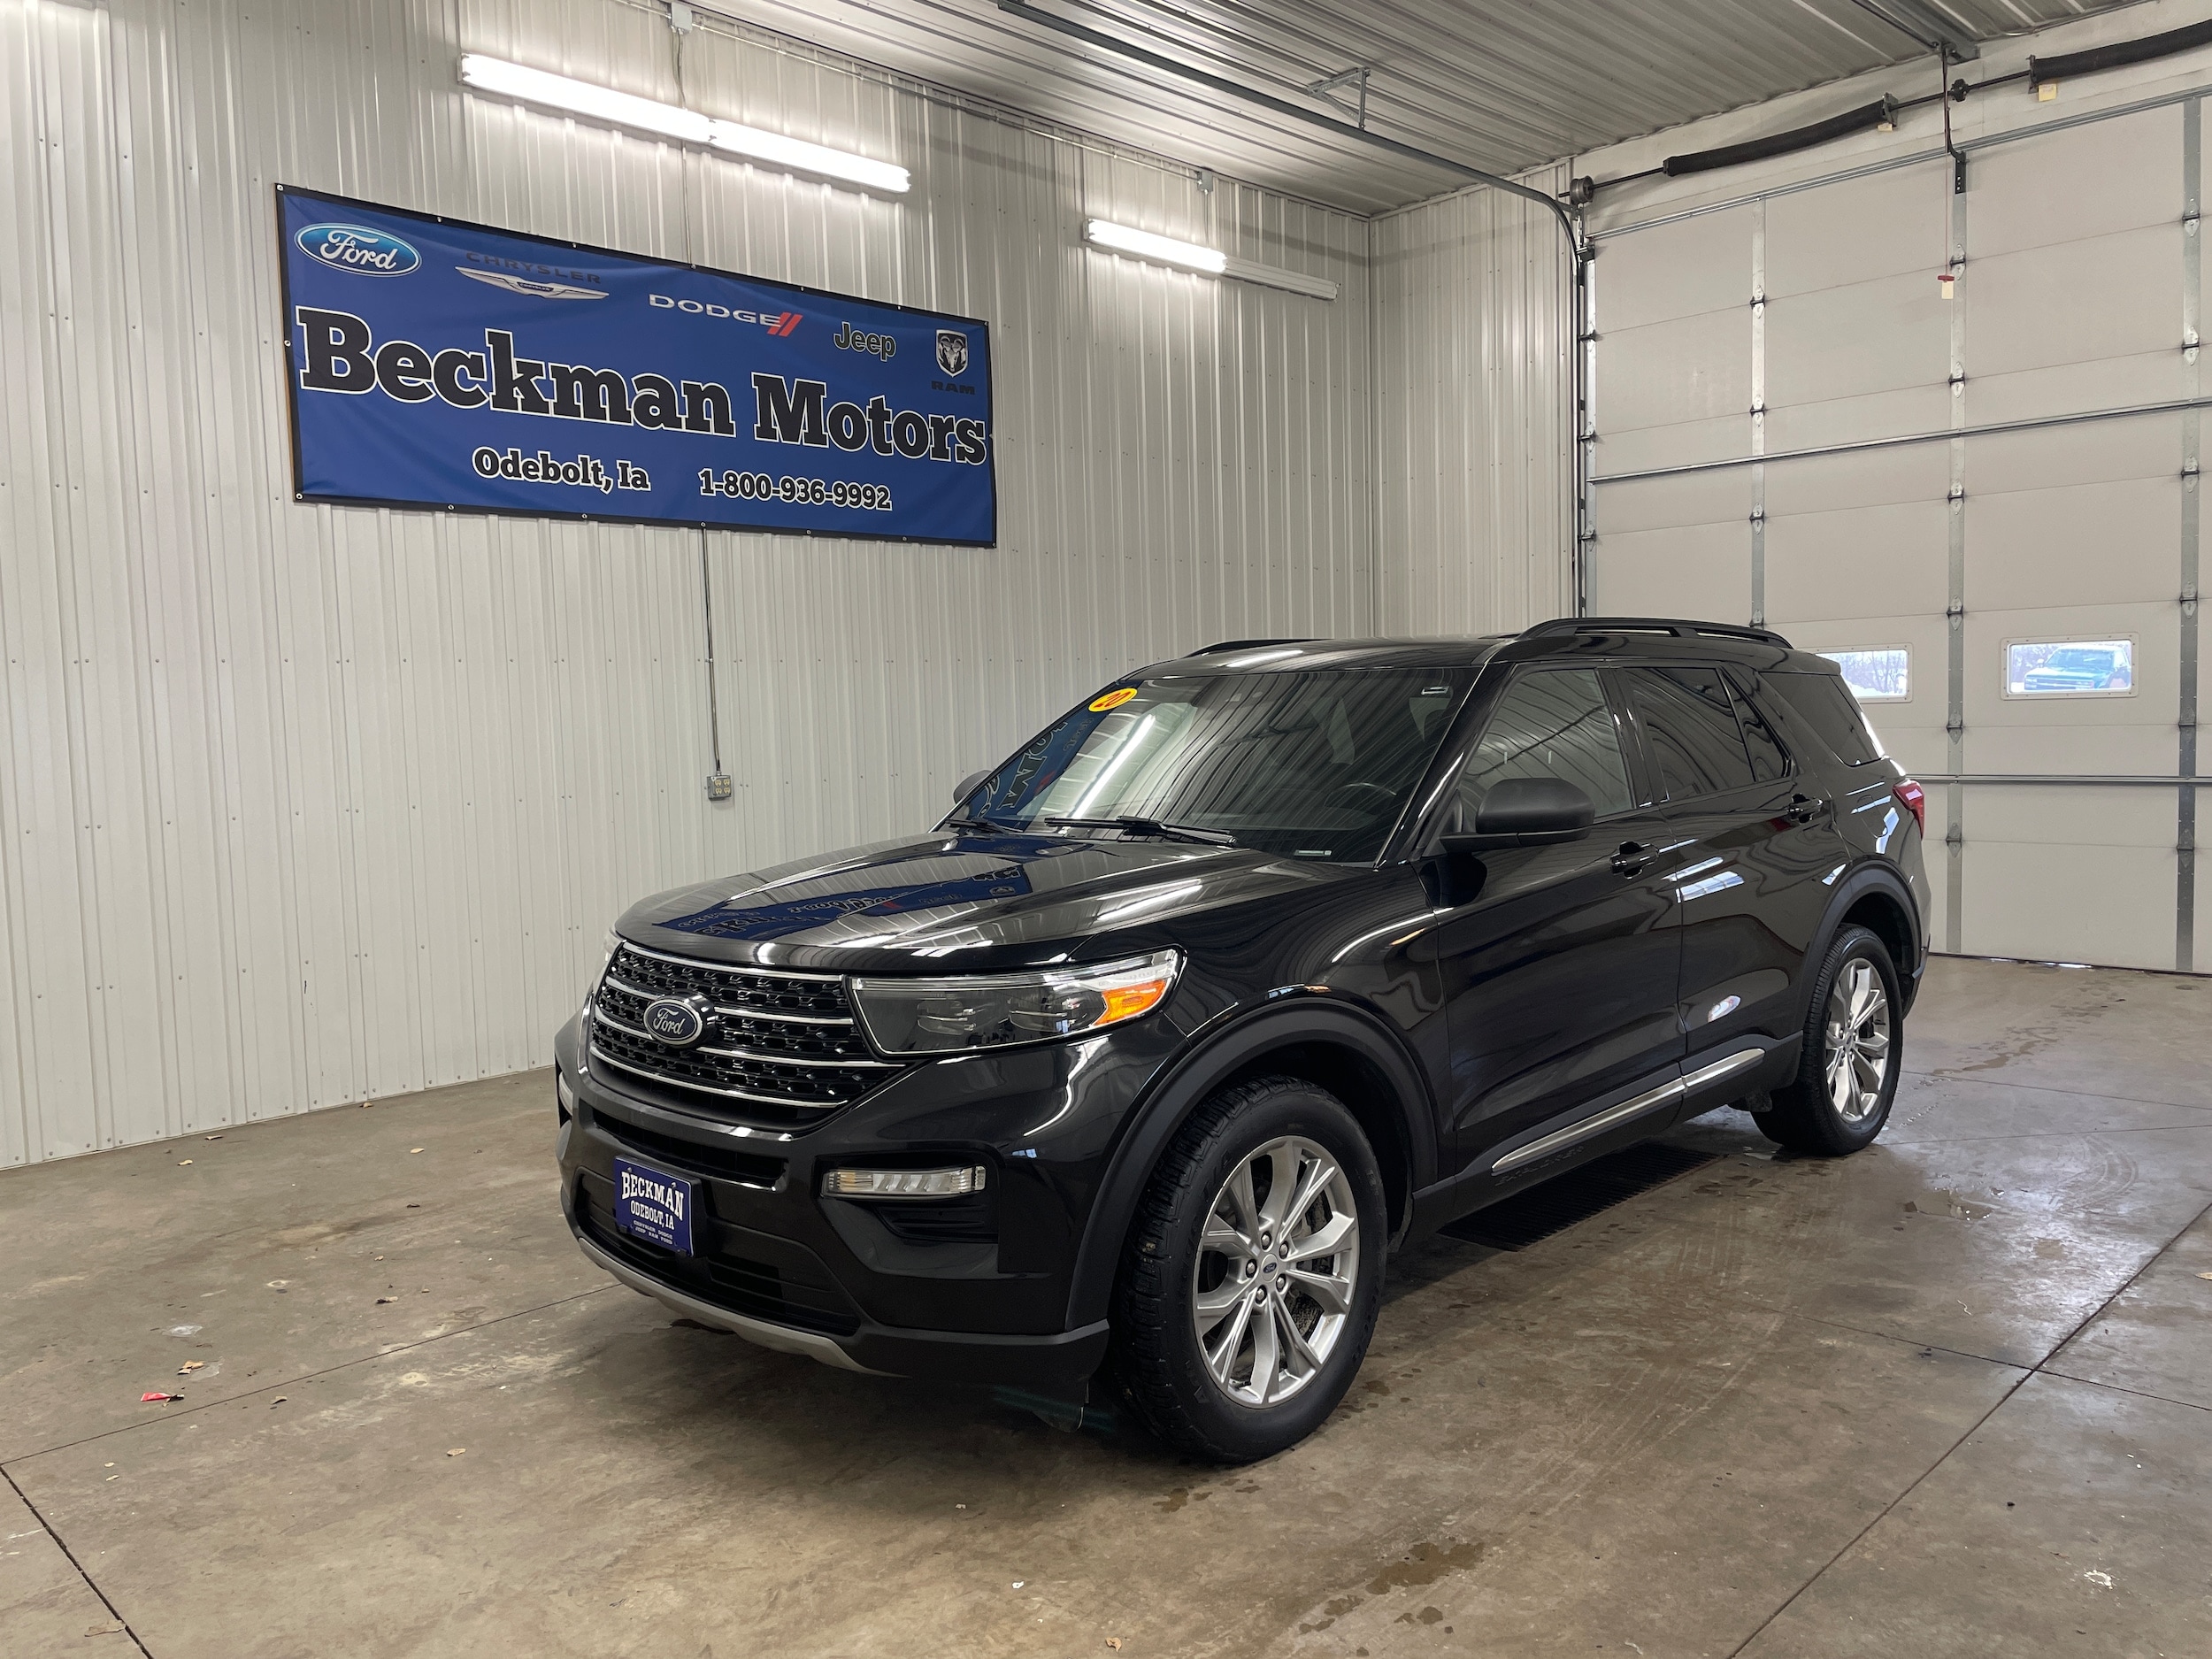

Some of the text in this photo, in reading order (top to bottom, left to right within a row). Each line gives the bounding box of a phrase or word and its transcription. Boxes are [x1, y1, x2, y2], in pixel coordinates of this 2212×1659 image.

[319, 230, 398, 270] Ford
[466, 252, 601, 284] CHRYSLER
[649, 294, 781, 326] DODGE
[833, 321, 896, 362] Jeep
[295, 305, 987, 465] Beckman Motors
[931, 380, 975, 395] RAM
[472, 446, 651, 494] Odebolt, Ia
[698, 467, 893, 511] 1-800-936-9992
[653, 1008, 686, 1034] Ford
[621, 1171, 684, 1221] BECKMAN
[630, 1200, 674, 1230] ODEBOLT, IA
